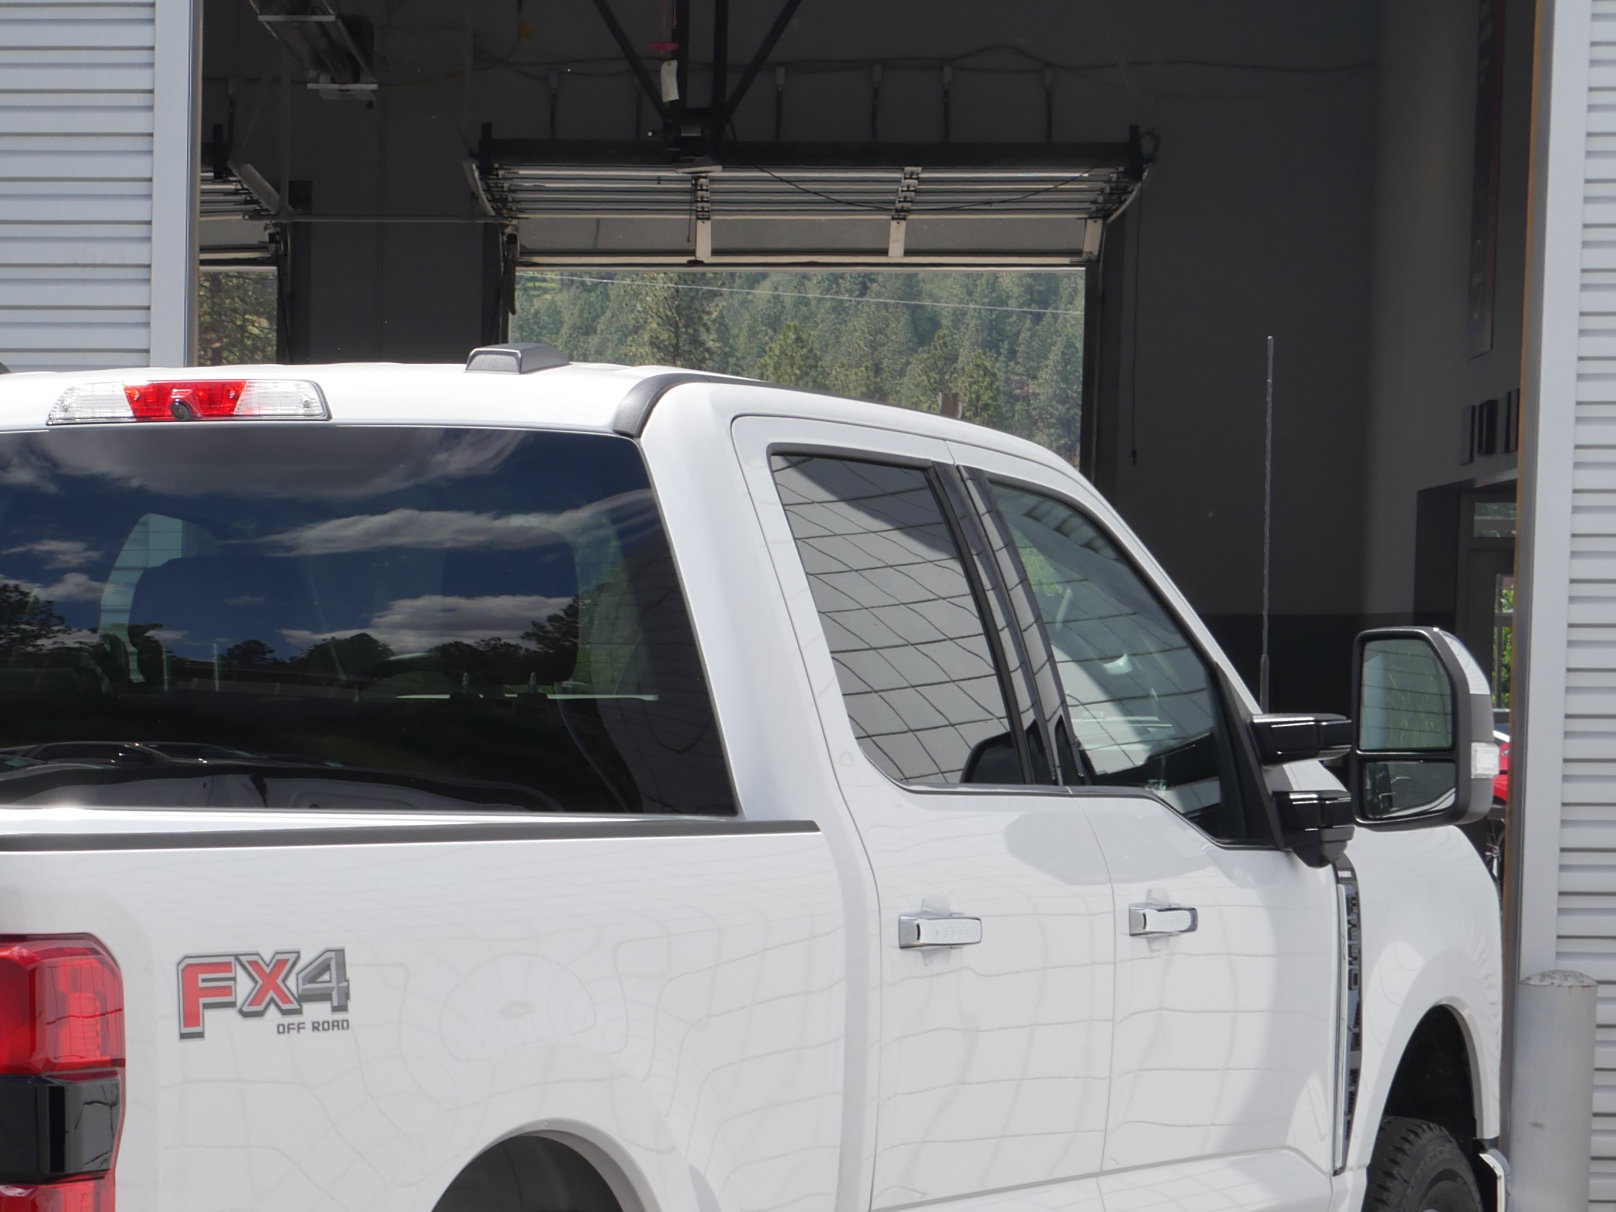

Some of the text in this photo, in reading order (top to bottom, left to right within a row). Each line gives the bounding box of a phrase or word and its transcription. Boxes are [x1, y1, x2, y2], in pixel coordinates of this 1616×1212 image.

[176, 947, 350, 1040] FX4
[276, 1019, 350, 1034] OFF ROAD
